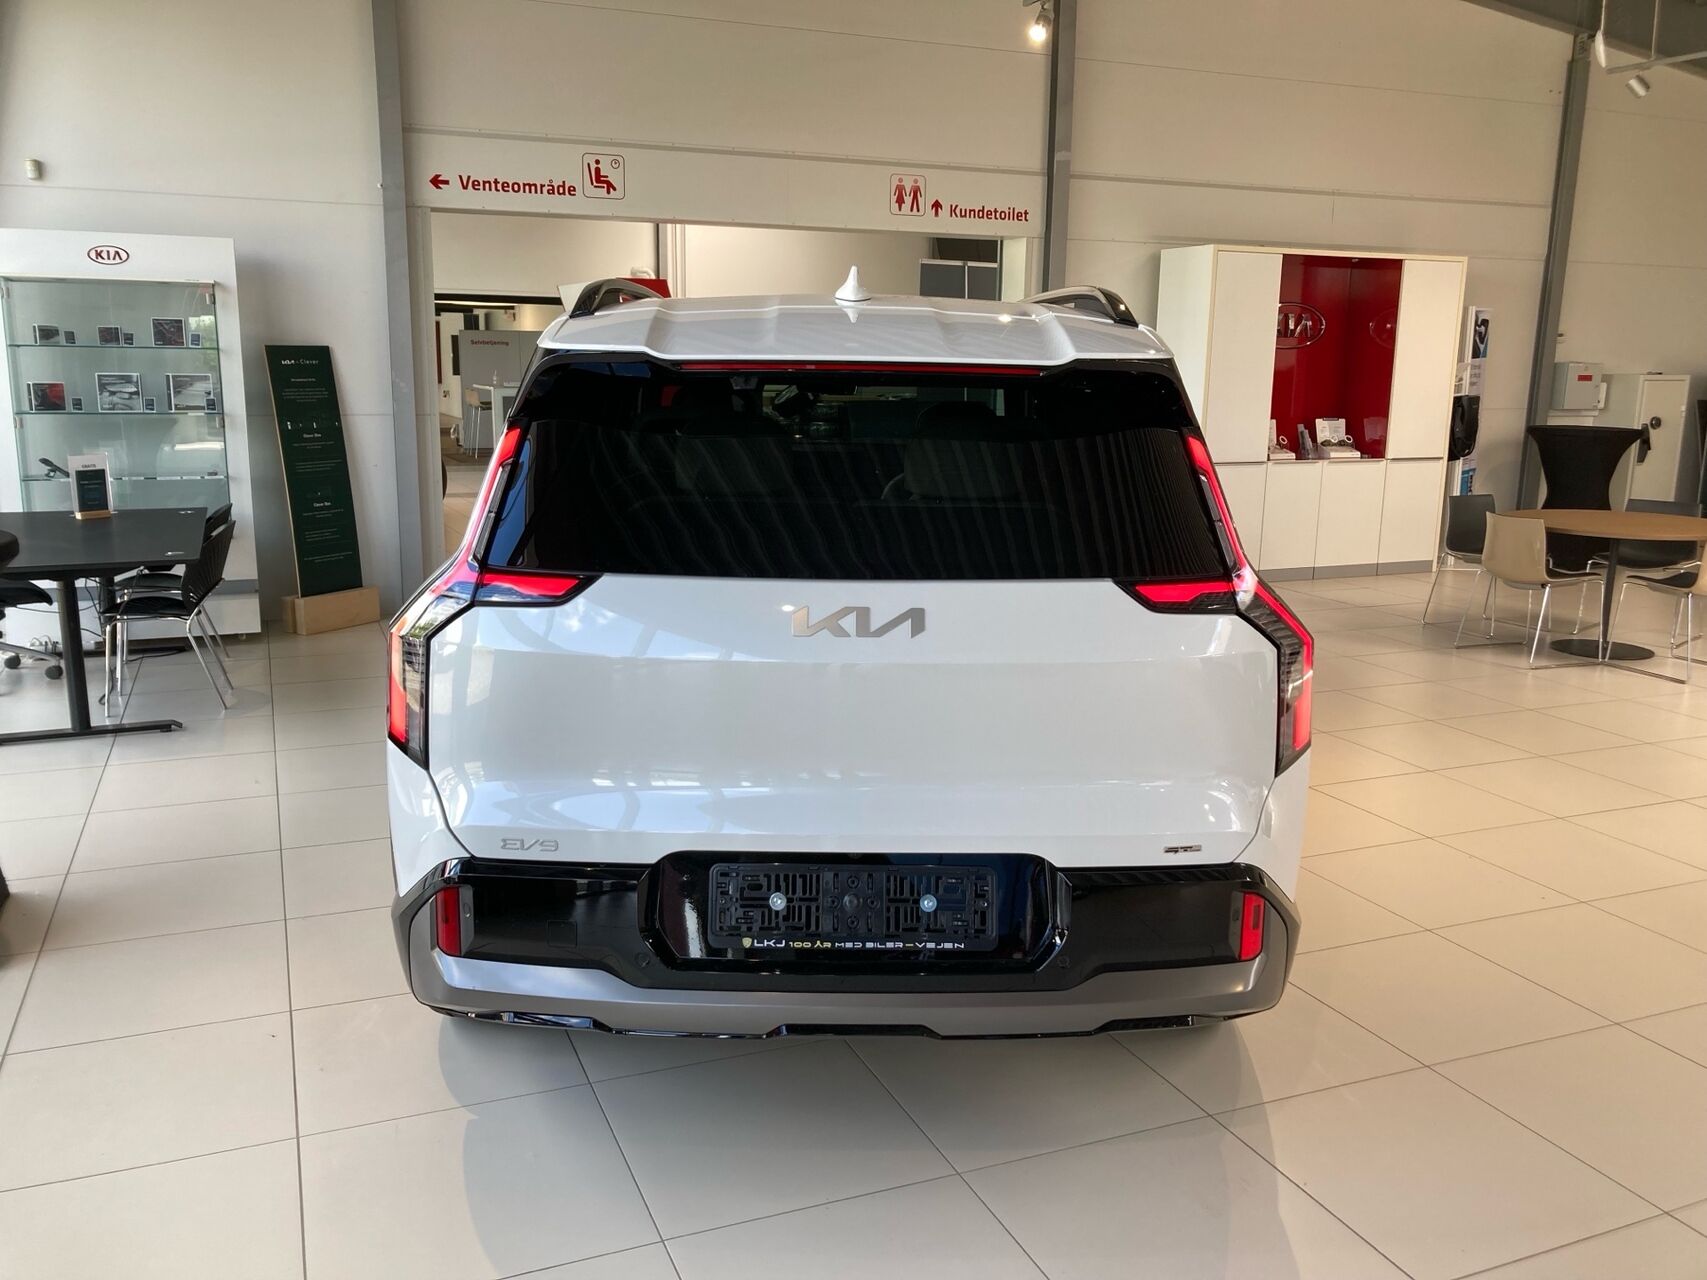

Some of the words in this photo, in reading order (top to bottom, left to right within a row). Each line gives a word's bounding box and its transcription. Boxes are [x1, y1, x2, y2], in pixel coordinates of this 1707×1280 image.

[458, 175, 577, 197] Venteområde
[949, 204, 1029, 222] Kundetoilet
[95, 249, 123, 261] KIA
[791, 605, 926, 639] KIA
[501, 838, 559, 852] EV9
[753, 939, 786, 947] LKJ
